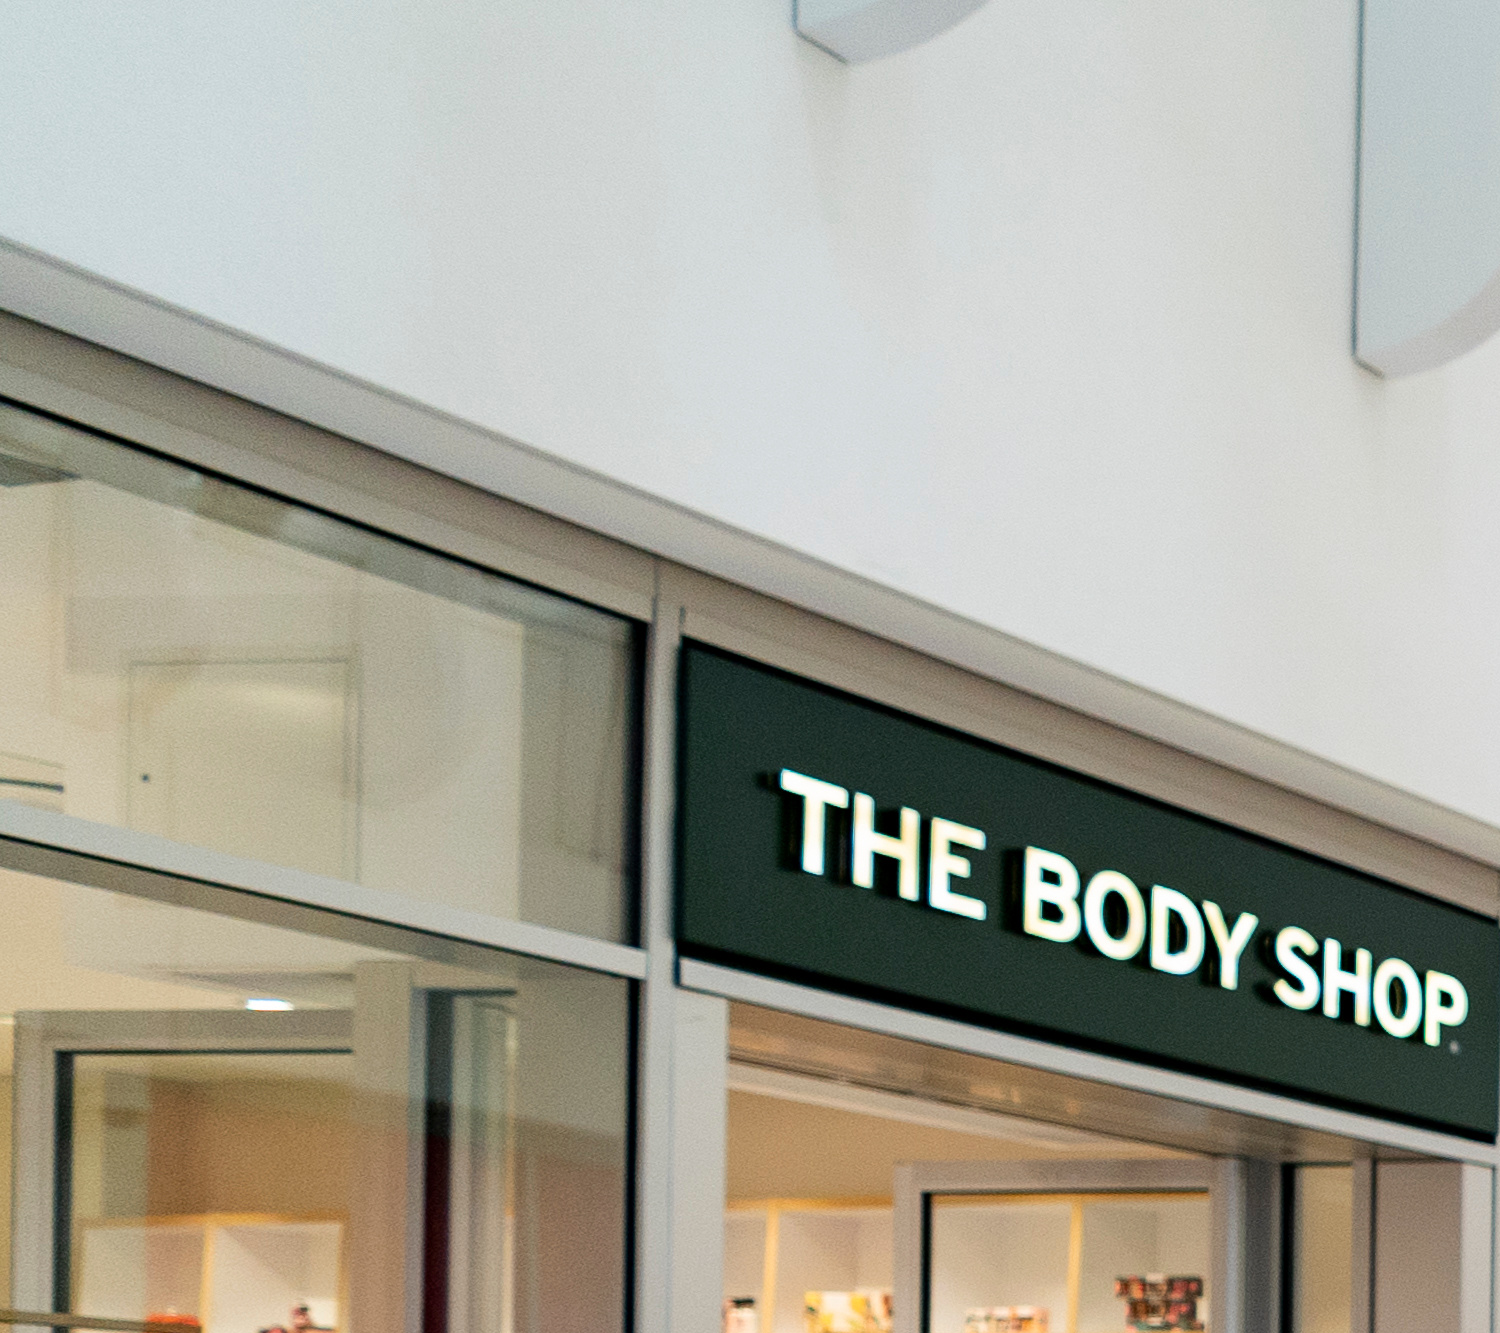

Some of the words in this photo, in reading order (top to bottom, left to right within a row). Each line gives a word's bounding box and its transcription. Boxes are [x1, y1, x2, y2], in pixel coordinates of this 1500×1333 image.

[780, 768, 987, 921] THE
[1023, 845, 1259, 991] BODY
[1273, 925, 1469, 1048] SHOP
